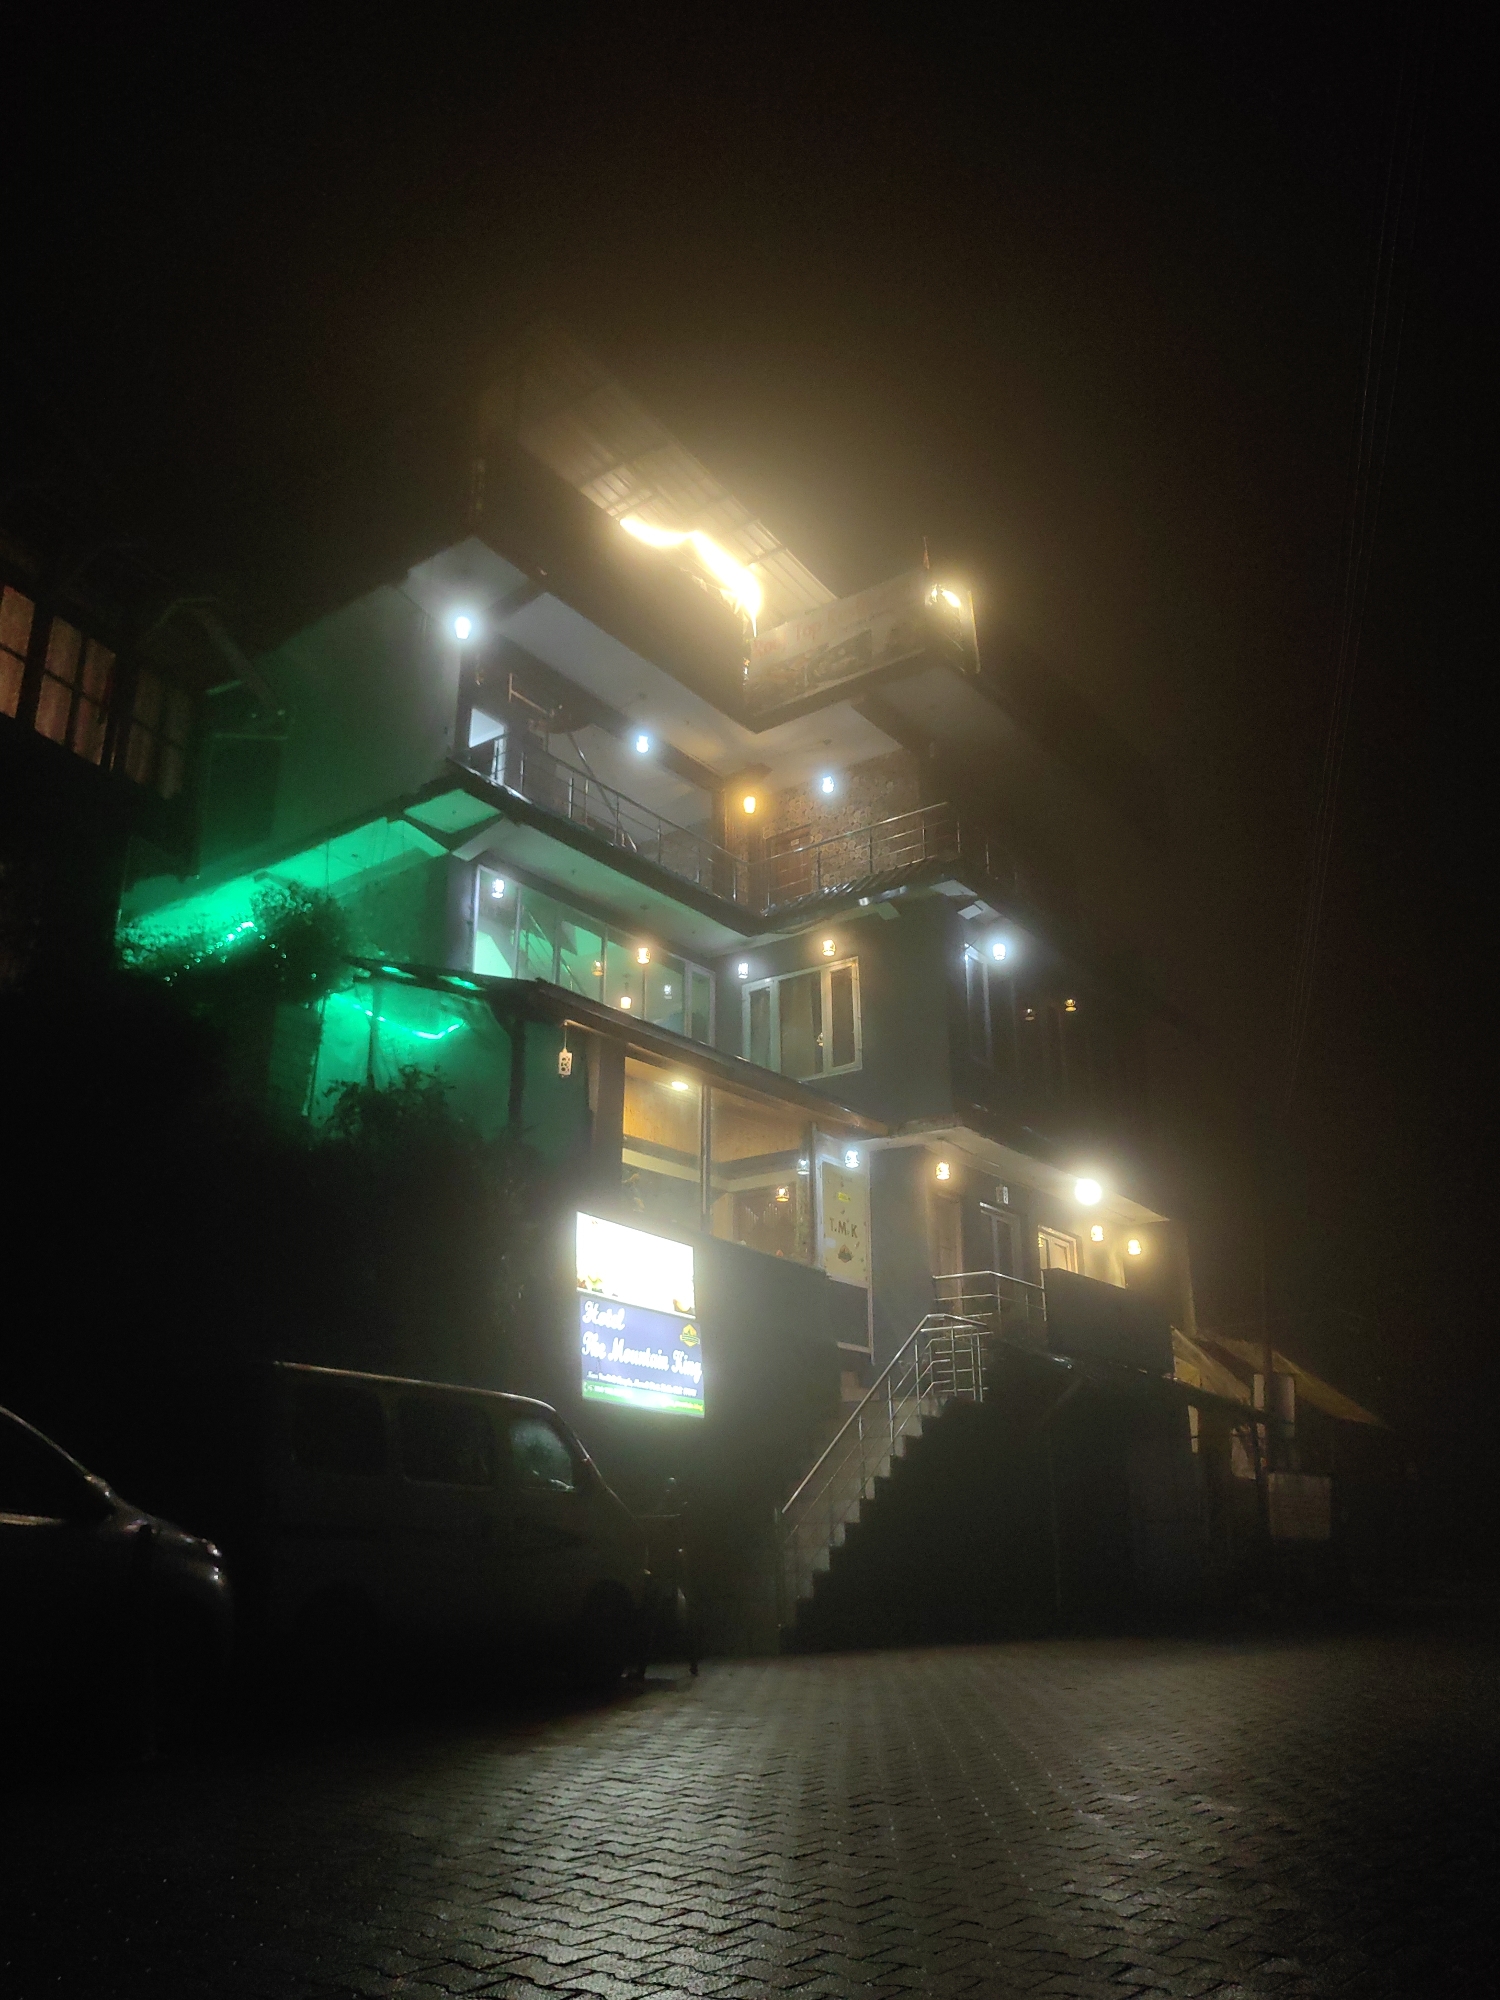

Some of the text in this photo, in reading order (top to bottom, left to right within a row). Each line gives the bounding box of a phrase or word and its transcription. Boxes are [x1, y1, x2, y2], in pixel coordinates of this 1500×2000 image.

[582, 1301, 625, 1331] Hotel
[582, 1331, 606, 1359] The
[607, 1337, 670, 1372] Mountain
[671, 1349, 703, 1385] King
